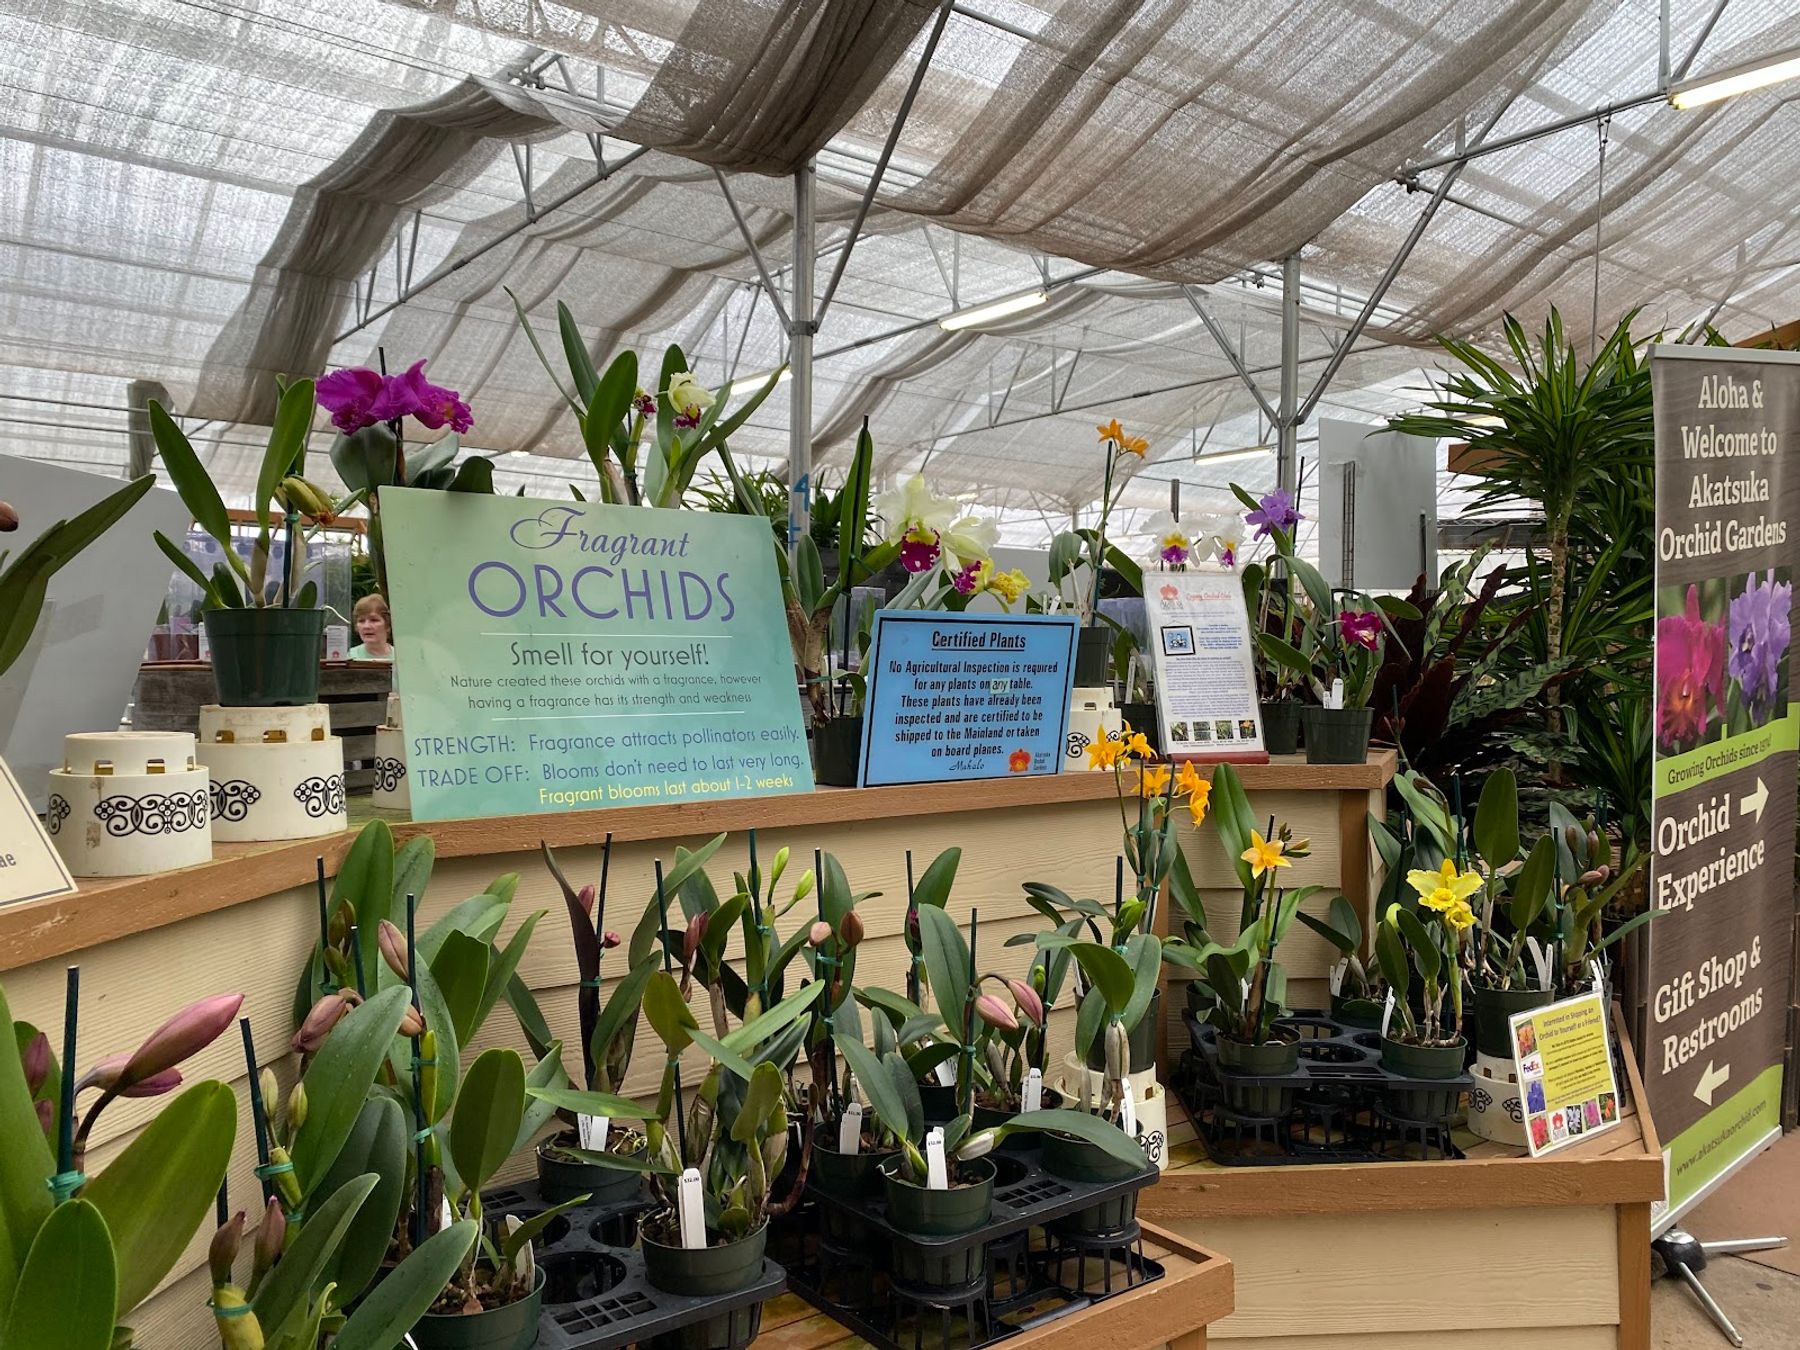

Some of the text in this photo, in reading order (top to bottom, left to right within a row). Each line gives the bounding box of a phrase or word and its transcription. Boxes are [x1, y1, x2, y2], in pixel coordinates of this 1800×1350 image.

[1698, 375, 1764, 408] Aloha &
[1681, 424, 1777, 459] Welcome to
[1689, 471, 1770, 508] Akatsuka
[509, 506, 689, 565] Fragrant
[1660, 516, 1786, 562] Orchid Gardens
[468, 561, 735, 622] ORCHIDS
[932, 631, 1026, 648] Certified Plants
[511, 642, 709, 671] Smell for yourself!
[889, 661, 1058, 676] No Agricultural Inspection is required
[450, 674, 761, 687] Nature created these orchids with a fragrance, however
[914, 678, 1033, 692] for any plants on any table.
[468, 697, 511, 711] having
[517, 699, 525, 708] a
[530, 695, 590, 710] fragrance
[594, 693, 614, 706] has
[617, 695, 628, 704] its
[632, 693, 675, 707] strength
[679, 693, 700, 704] and
[901, 694, 1042, 709] These plants have already been
[895, 710, 1043, 727] inspected and are certified to be
[895, 726, 1040, 744] shipped to the Mainland or taken
[415, 725, 800, 756] STRENGTH: Fragrance attracts pollinators easily.
[931, 744, 1004, 758] on board planes.
[417, 752, 804, 787] TRADE OFF: Blooms don't need to last very long.
[1668, 762, 1704, 785] Growing
[1705, 750, 1737, 771] Orchids
[1739, 741, 1758, 761] since
[539, 773, 793, 806] Fragrant blooms last about 1-2 weeks
[1658, 793, 1730, 856] Orchid
[1657, 839, 1764, 912] Experience
[1654, 935, 1761, 1023] Gift Shop &
[1662, 987, 1762, 1075] Restrooms
[1523, 1061, 1540, 1074] FedEx
